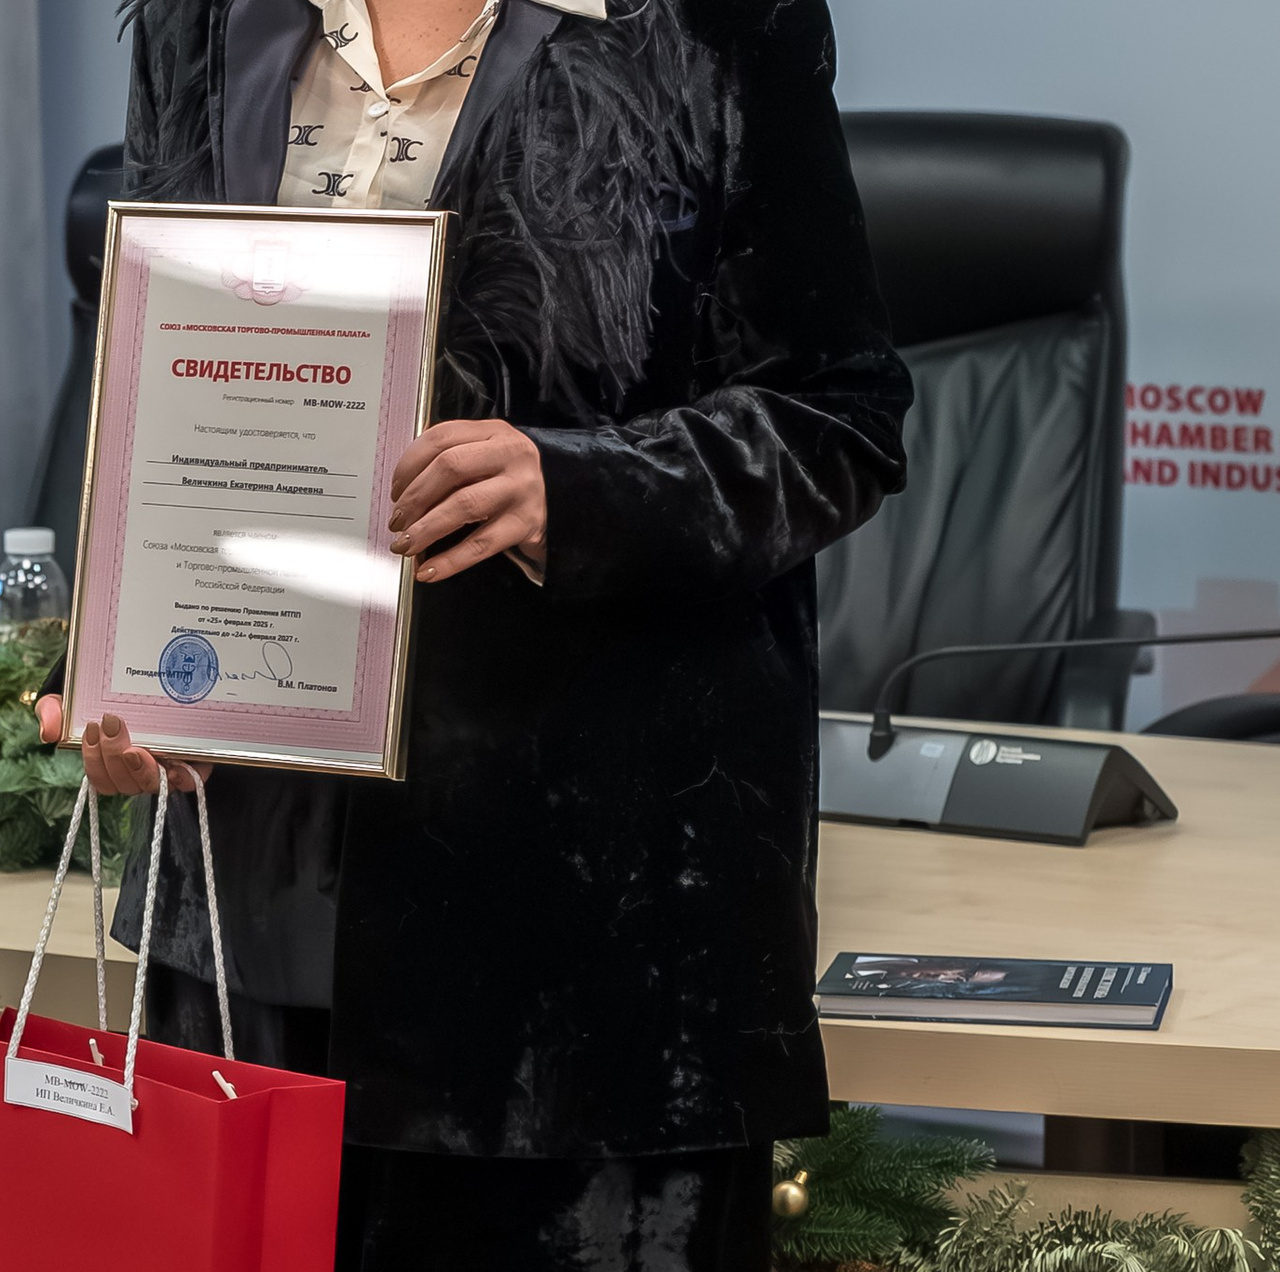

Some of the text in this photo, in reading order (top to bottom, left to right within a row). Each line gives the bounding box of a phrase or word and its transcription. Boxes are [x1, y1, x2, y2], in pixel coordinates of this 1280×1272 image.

[159, 323, 182, 331] СОЮЗ
[237, 326, 336, 337] ТОРГОВО-ПРОМЫШЛЕННАЯ
[171, 358, 352, 385] СВИДЕТЕЛЬСТВО
[194, 424, 238, 436] Настоящим
[302, 432, 316, 440] что
[1126, 421, 1273, 454] HAMBER
[171, 455, 328, 474] Индивидуальный предприниматель
[1188, 461, 1280, 494] INDU
[181, 477, 324, 495] Величкина Екатерина Андреевна
[143, 540, 168, 551] Союза
[195, 579, 285, 594] Российской Федерации
[174, 602, 200, 611] Выдано
[297, 681, 337, 693] Платонов
